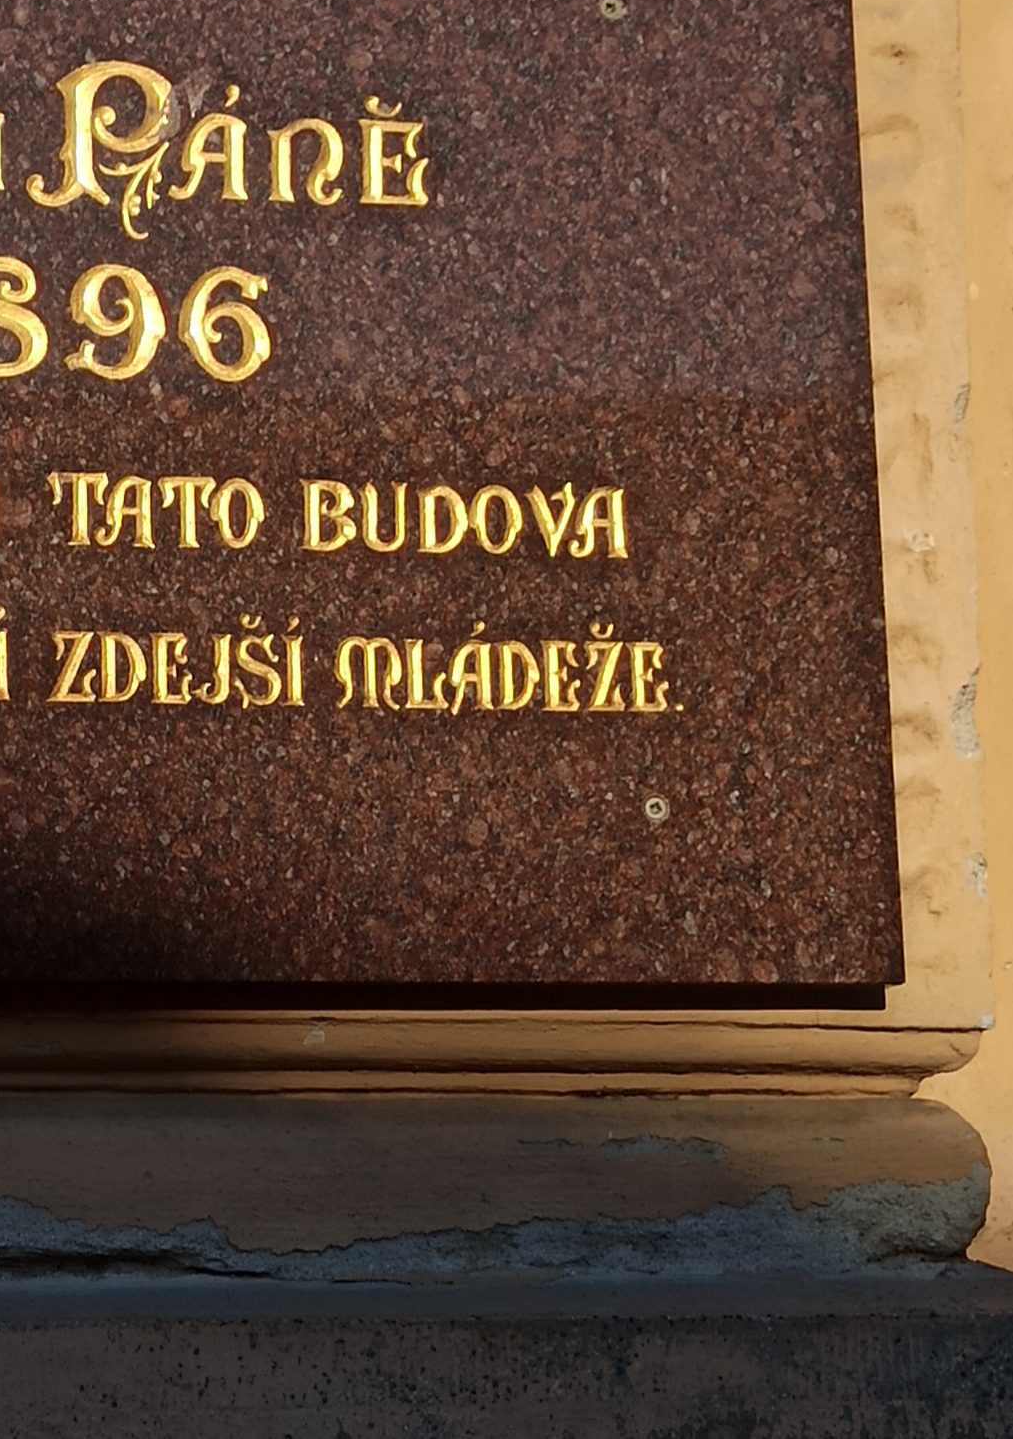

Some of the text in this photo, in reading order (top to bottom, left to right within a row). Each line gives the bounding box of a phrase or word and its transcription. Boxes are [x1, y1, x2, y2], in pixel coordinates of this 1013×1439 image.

[46, 470, 266, 551] TATO
[299, 479, 630, 560] BUDOVA
[45, 613, 306, 710] ZDEJŠÍ
[333, 620, 685, 716] MLÁDEŽE.
